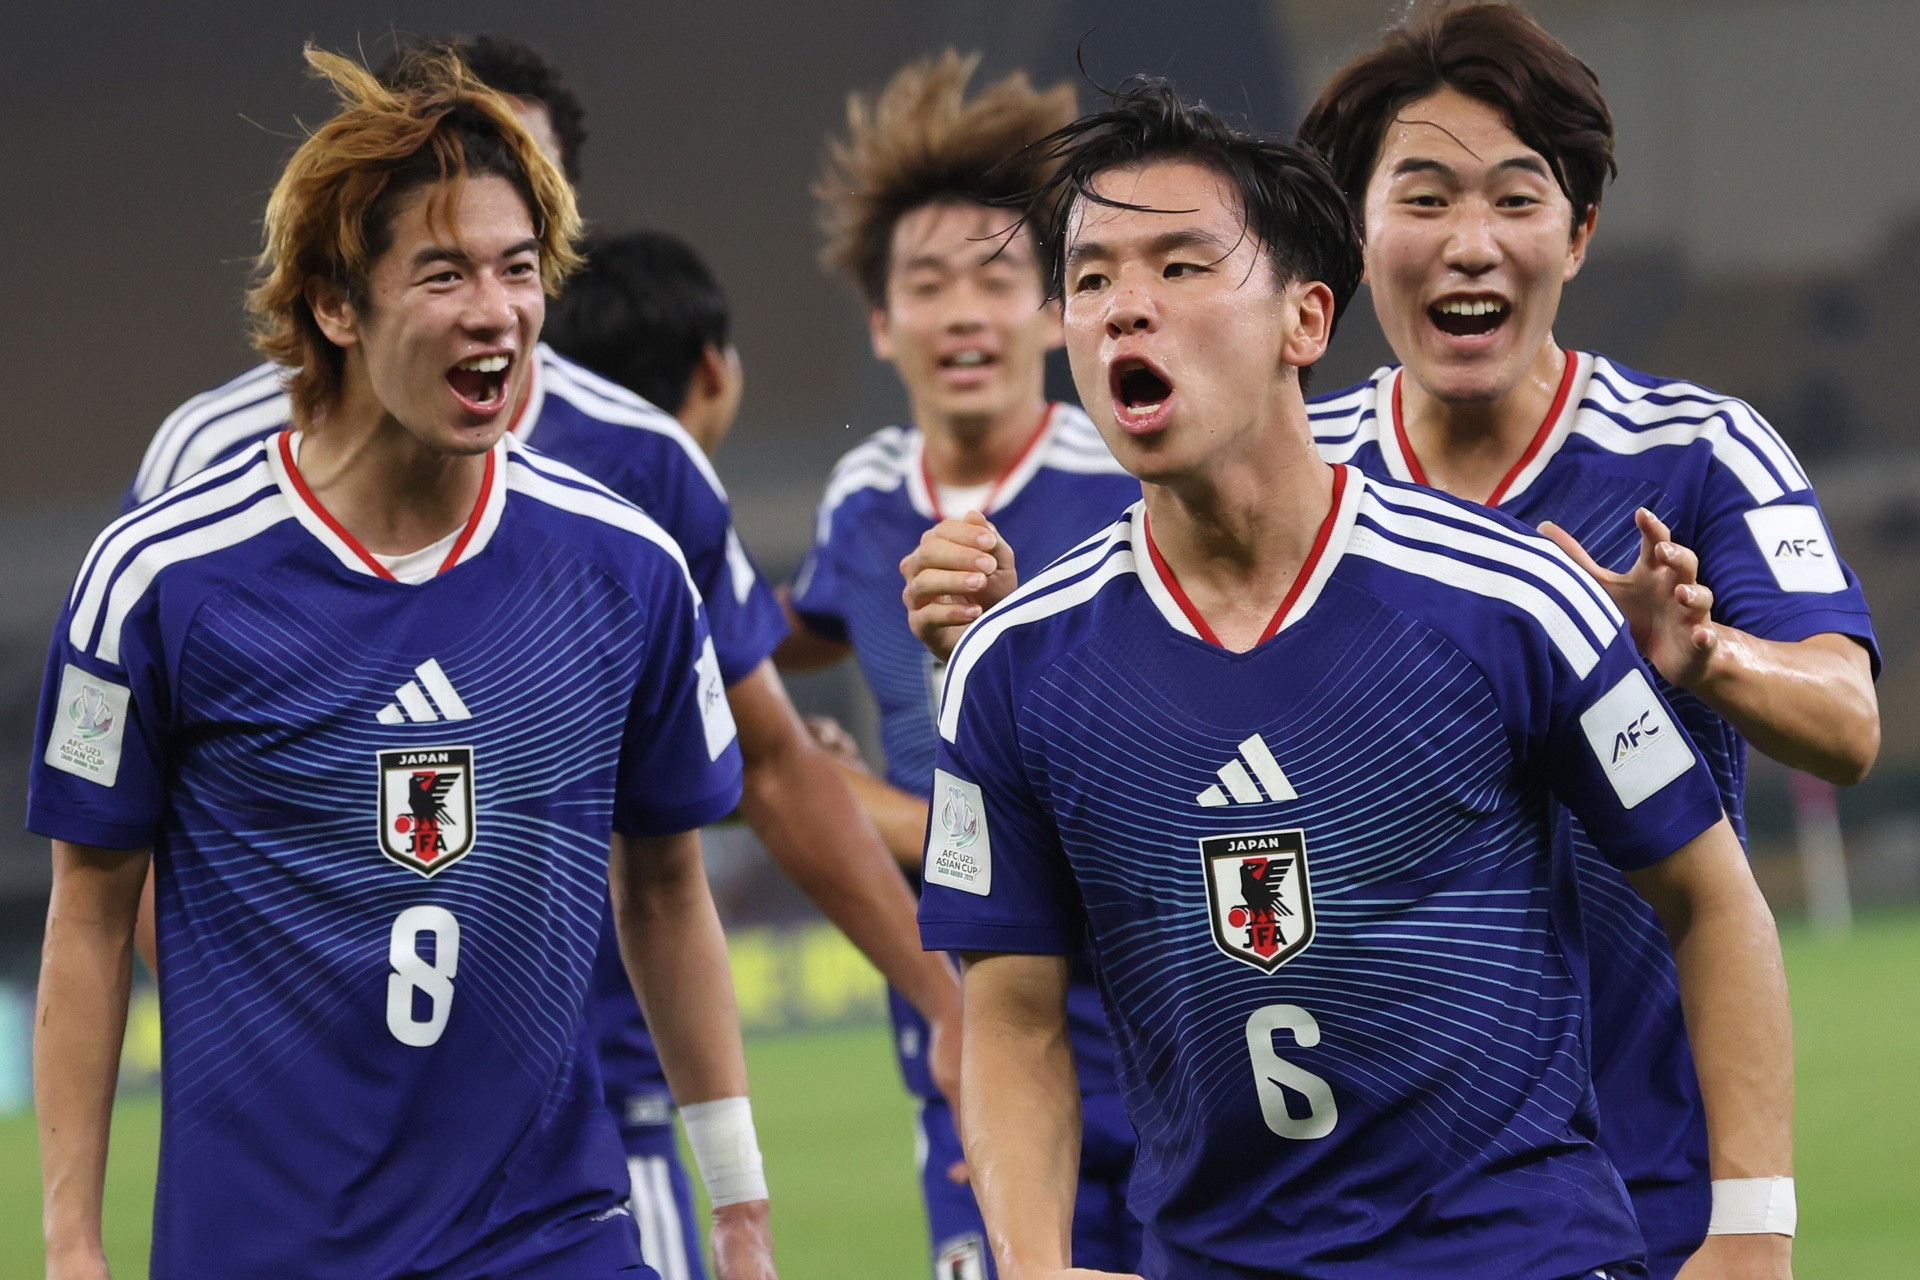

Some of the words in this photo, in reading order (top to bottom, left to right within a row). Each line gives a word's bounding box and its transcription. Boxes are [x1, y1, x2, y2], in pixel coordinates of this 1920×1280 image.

[1775, 539, 1824, 557] AFC
[1612, 709, 1660, 765] AFC
[60, 745, 86, 760] ASIAN
[87, 755, 105, 765] CUP
[67, 738, 84, 751] AFC
[86, 745, 101, 757] U23
[399, 752, 449, 765] JAPAN
[405, 834, 448, 854] JFA
[1227, 837, 1280, 853] JAPAN
[936, 857, 961, 870] ASIAN
[962, 863, 978, 875] CUP
[942, 849, 958, 860] AFC
[960, 853, 974, 865] U23
[1243, 925, 1288, 949] JFA
[386, 905, 461, 1048] 8
[1245, 1004, 1339, 1140] 6
